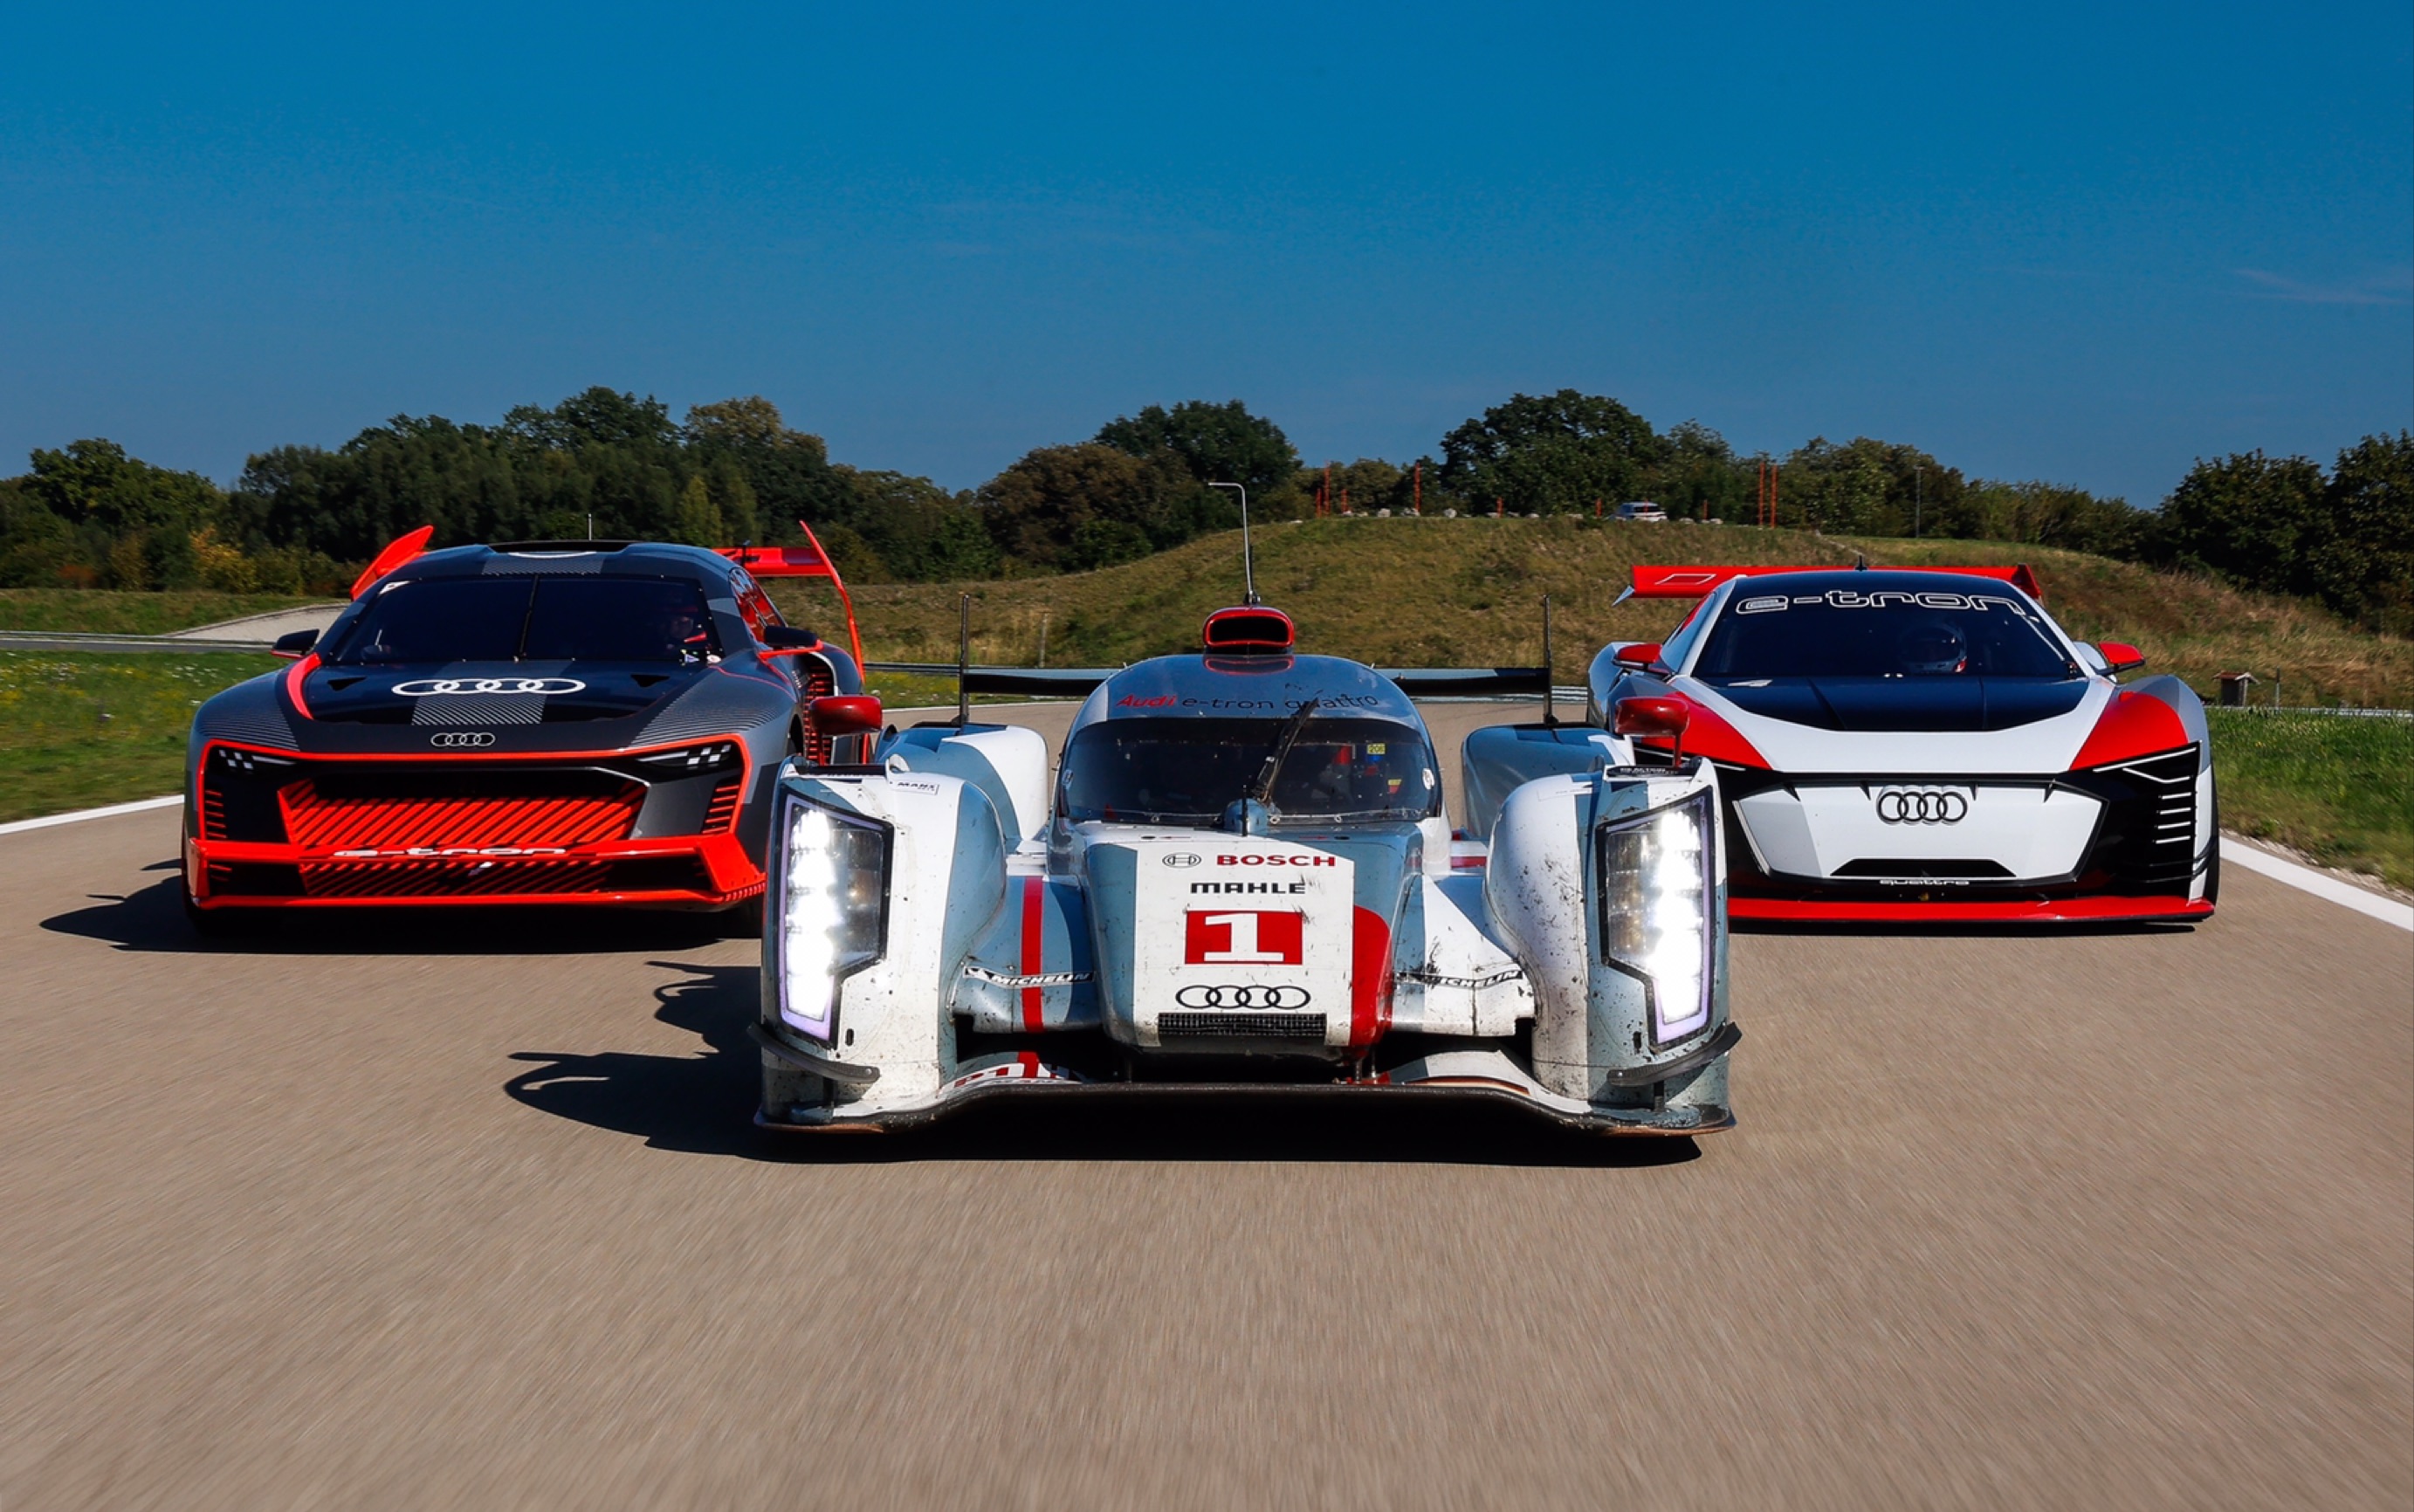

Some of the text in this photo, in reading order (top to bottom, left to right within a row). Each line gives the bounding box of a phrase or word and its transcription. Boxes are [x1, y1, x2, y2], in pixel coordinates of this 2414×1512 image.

[1736, 590, 2026, 615] e-tron
[1116, 694, 1379, 710] Audi e-tron qattro
[334, 848, 566, 856] e-tron
[1216, 855, 1336, 867] BOSCH
[1191, 883, 1306, 894] MAHLE
[1203, 912, 1285, 962] 1
[990, 972, 1090, 986] MICHELIN
